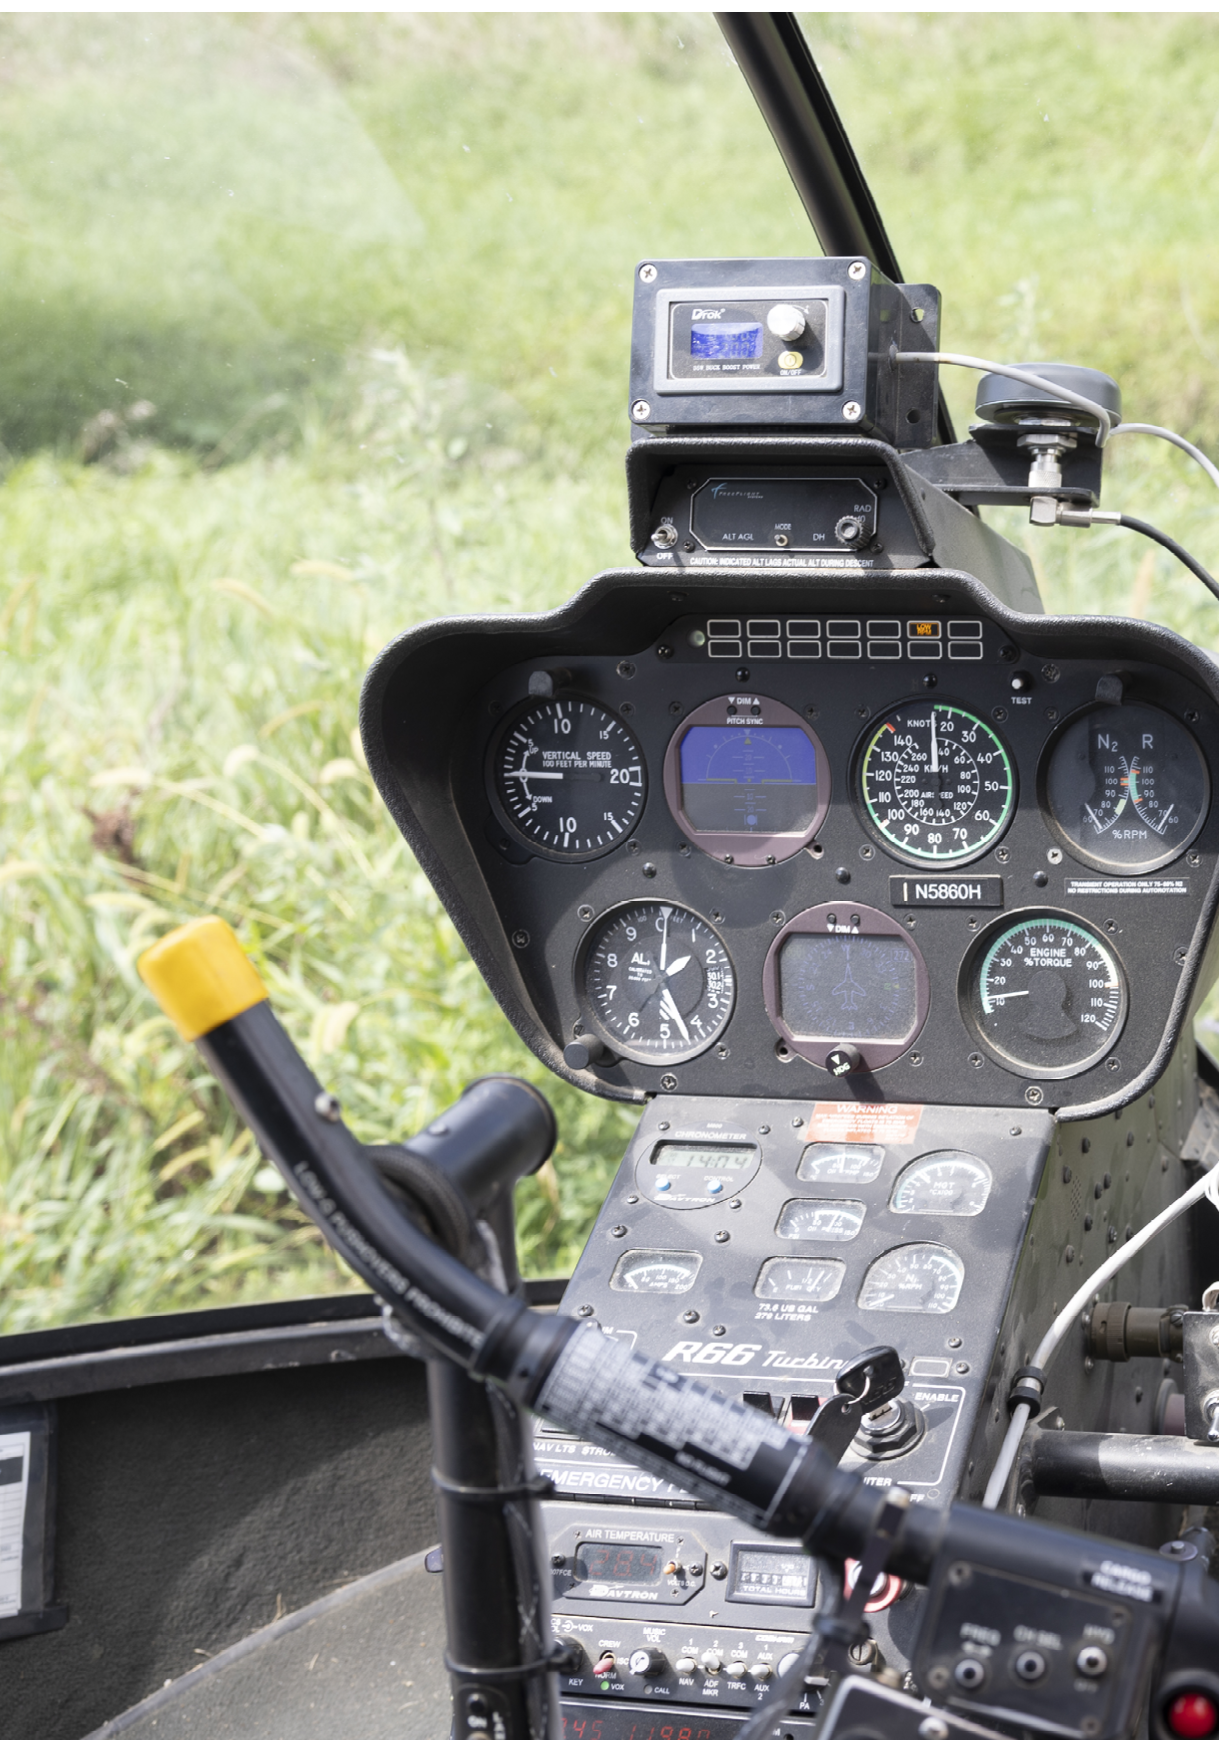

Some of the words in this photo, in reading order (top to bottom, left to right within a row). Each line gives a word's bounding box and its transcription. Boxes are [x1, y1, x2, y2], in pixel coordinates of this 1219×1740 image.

[692, 309, 721, 320] Drok
[661, 517, 673, 525] ON
[690, 557, 718, 566] CAUTION:
[719, 558, 751, 566] INDICATED
[783, 559, 806, 567] ACTUAL
[808, 559, 819, 567] ALT
[820, 559, 843, 567] DURING
[843, 559, 874, 567] DESCENT
[1011, 697, 1032, 705] TEST
[554, 719, 571, 733] 10
[940, 722, 954, 731] 20
[599, 731, 609, 739] 15
[1142, 734, 1153, 749] R
[587, 752, 611, 760] SPEED
[977, 754, 992, 763] 40
[610, 769, 630, 783] 20
[888, 809, 905, 819] 100
[559, 817, 576, 833] 10
[928, 833, 942, 843] 80
[916, 884, 981, 899] N5860H
[835, 925, 850, 933] DIM
[1030, 948, 1066, 957] ENGINE
[1074, 948, 1086, 956] 80
[1024, 958, 1072, 967] %TORQUE
[1089, 980, 1103, 988] 100
[833, 1063, 850, 1076] HDG
[837, 1105, 898, 1114] WARNING
[675, 1131, 747, 1139] CHRONOMETER
[330, 1210, 409, 1295] PUSHOVERS
[797, 1305, 819, 1313] GAL
[774, 1313, 811, 1321] LITERS
[662, 1341, 762, 1365] R66
[915, 1393, 959, 1402] ENABLE
[556, 1445, 575, 1453] LTS
[586, 1529, 602, 1539] AIR
[605, 1530, 674, 1543] TEMPERATURE
[589, 1585, 658, 1600] DAVTRON
[775, 1587, 806, 1596] HOURS
[643, 1627, 666, 1635] MUSIC
[598, 1640, 621, 1648] CREW
[682, 1646, 698, 1654] COM
[731, 1650, 748, 1658] COM
[757, 1652, 773, 1660] AUX
[617, 1657, 629, 1665] ISC
[679, 1678, 694, 1686] NAV
[704, 1679, 718, 1687] ADF
[727, 1682, 746, 1690] TRFC
[611, 1683, 624, 1691] VOX
[655, 1686, 670, 1694] CALL
[754, 1684, 769, 1692] AUX
[703, 1688, 718, 1696] MKR
[800, 1702, 810, 1710] PA
